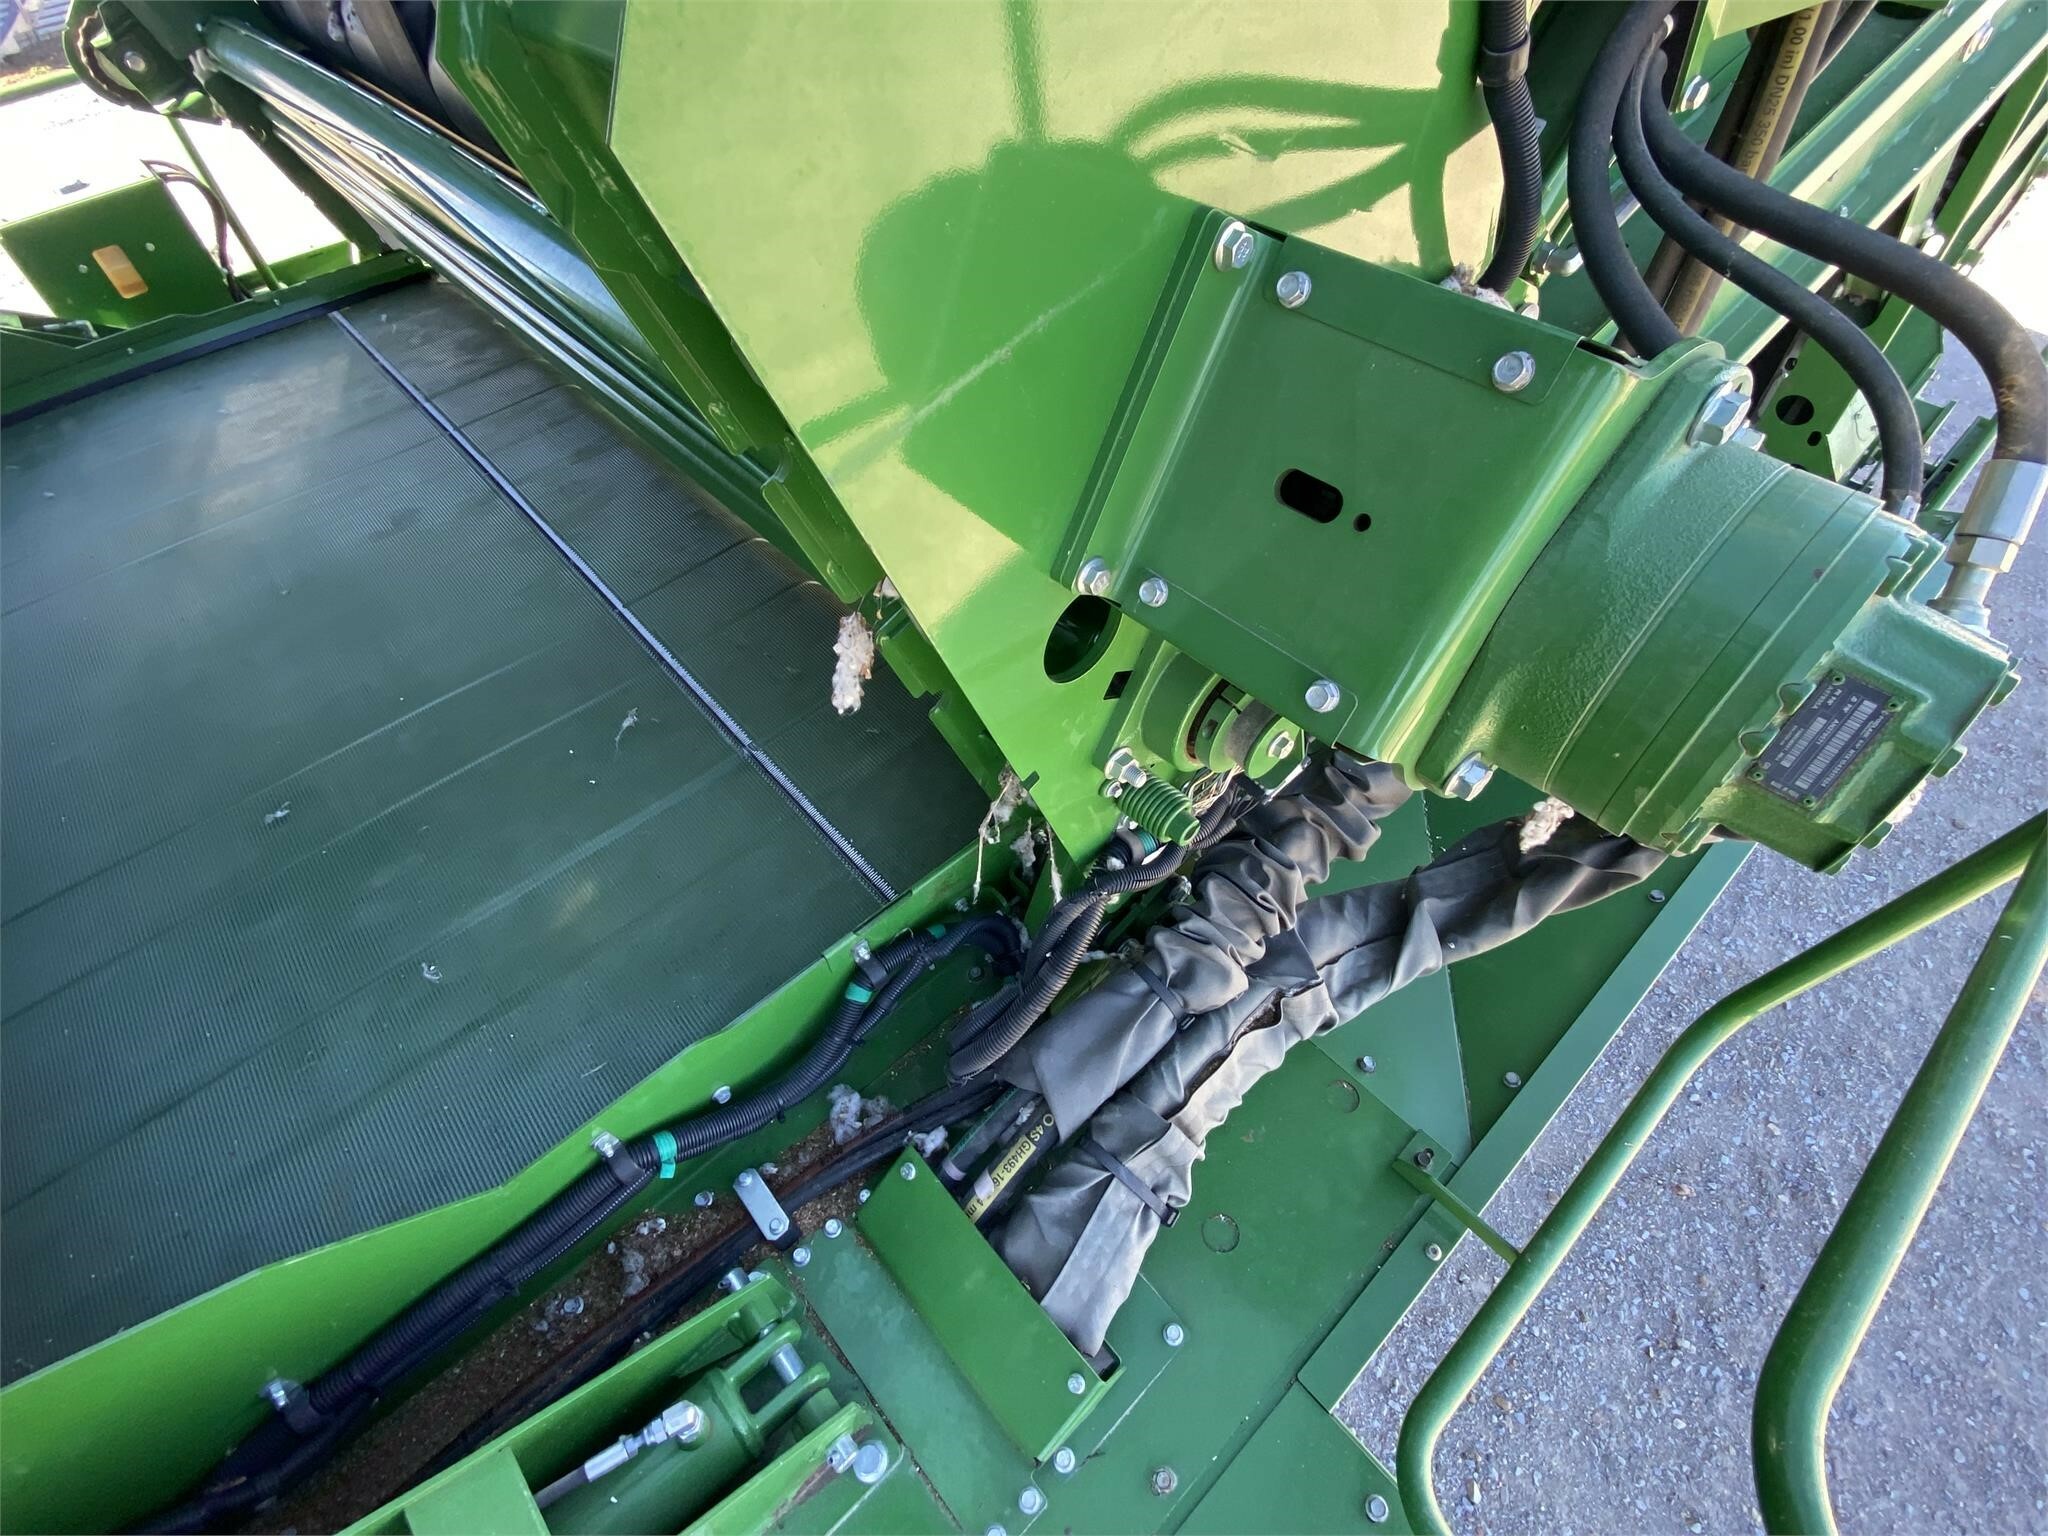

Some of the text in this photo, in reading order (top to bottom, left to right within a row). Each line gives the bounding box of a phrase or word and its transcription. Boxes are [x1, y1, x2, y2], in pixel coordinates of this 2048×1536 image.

[1762, 74, 1789, 118] DN25
[1751, 119, 1770, 146] 350
[1030, 1124, 1044, 1142] 4S
[992, 1141, 1031, 1186] GH493-16
